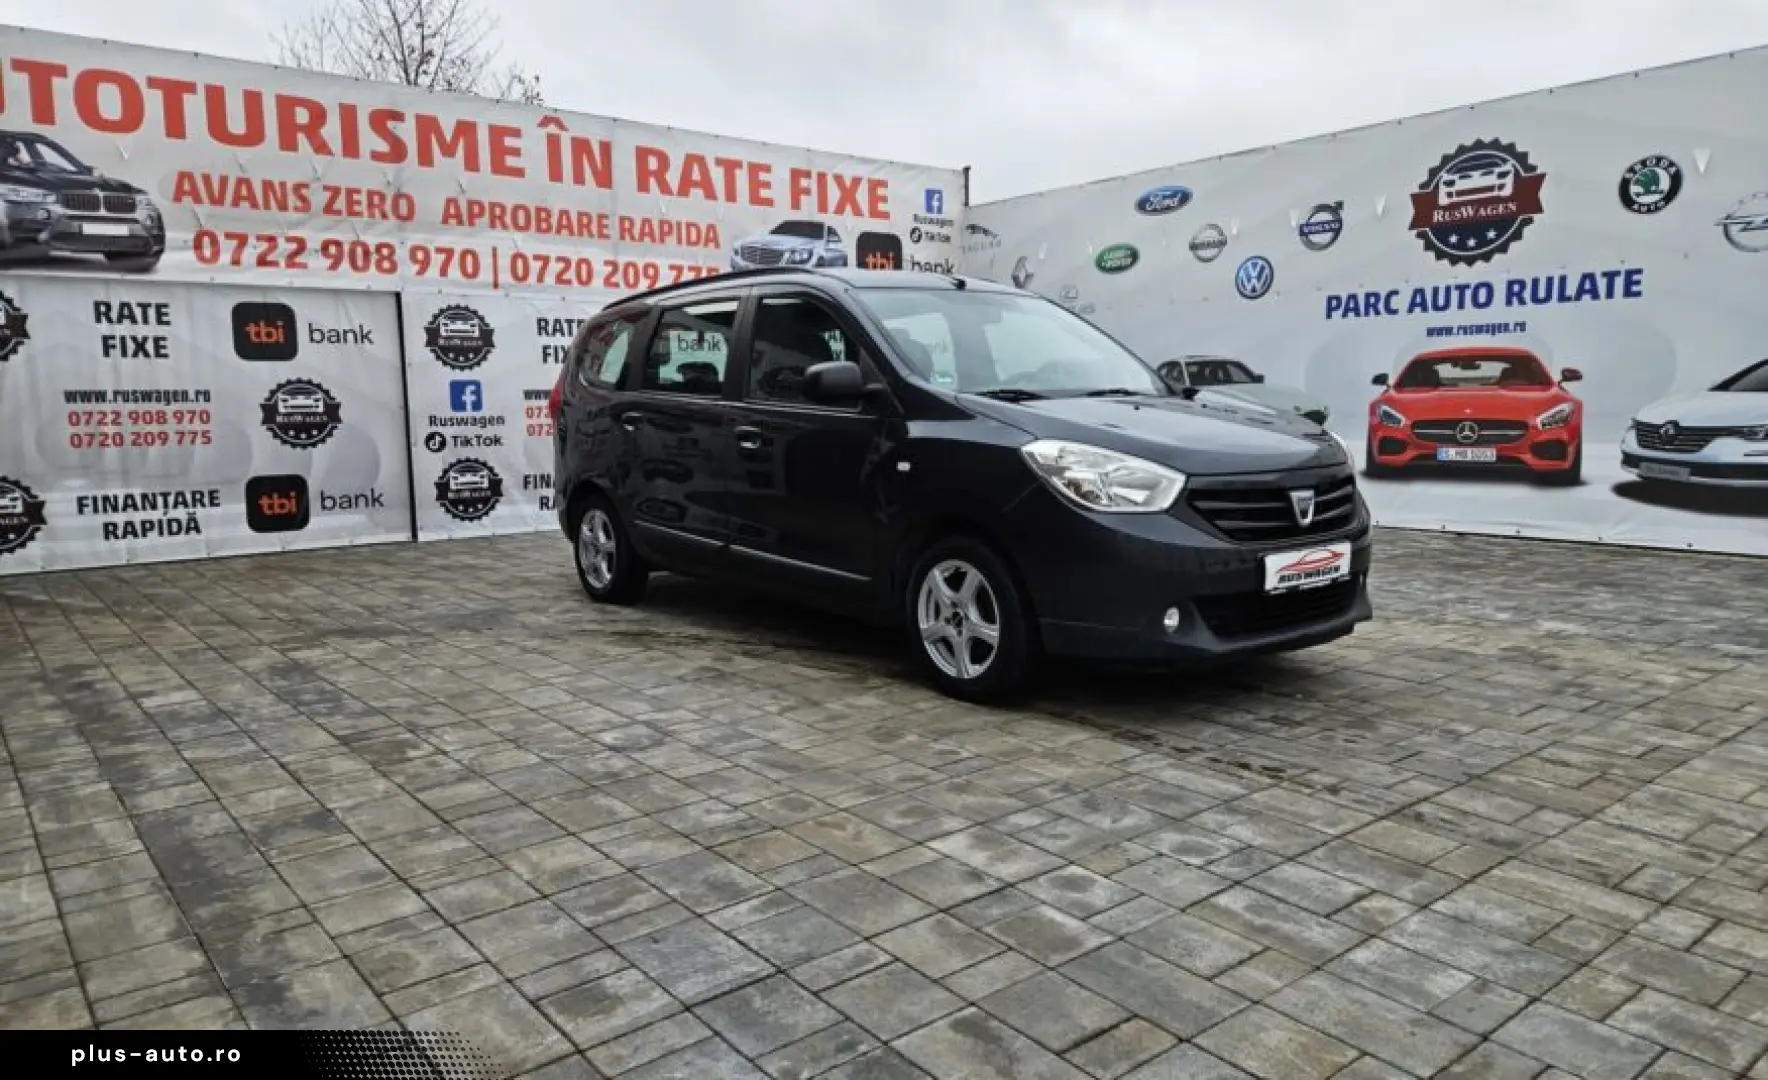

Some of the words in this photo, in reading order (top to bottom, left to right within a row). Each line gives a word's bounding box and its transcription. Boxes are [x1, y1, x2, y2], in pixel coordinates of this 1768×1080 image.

[0, 57, 526, 180] TOTURISME
[537, 115, 613, 191] ÎN
[636, 145, 774, 208] RATE
[789, 167, 892, 221] FIXE
[172, 170, 312, 214] AVANS
[322, 184, 416, 223] ZERO
[441, 197, 609, 239] APROBARE
[619, 213, 721, 249] RAPIDA
[193, 229, 308, 271] 0722
[320, 238, 398, 275] 908
[409, 245, 480, 281] 970
[509, 251, 594, 289] 0720
[603, 259, 660, 290] 209
[1325, 288, 1400, 320] PARC
[1406, 280, 1495, 315] AUTO
[1505, 267, 1645, 307] RULATE
[93, 300, 171, 326] RATE
[246, 321, 284, 344] tbi
[308, 323, 374, 345] bank
[102, 334, 170, 360] FIXE
[64, 389, 211, 406] www.ruswagen.ro
[67, 411, 123, 428] 0722
[128, 410, 168, 426] 908
[174, 410, 211, 426] 970
[428, 415, 506, 429] Ruswagen
[70, 432, 124, 449] 0720
[130, 431, 169, 448] 209
[176, 430, 212, 446] 775
[450, 434, 503, 448] TikTok
[258, 492, 298, 516] tbi
[320, 489, 384, 512] bank
[104, 512, 202, 541] RAPIDĂ
